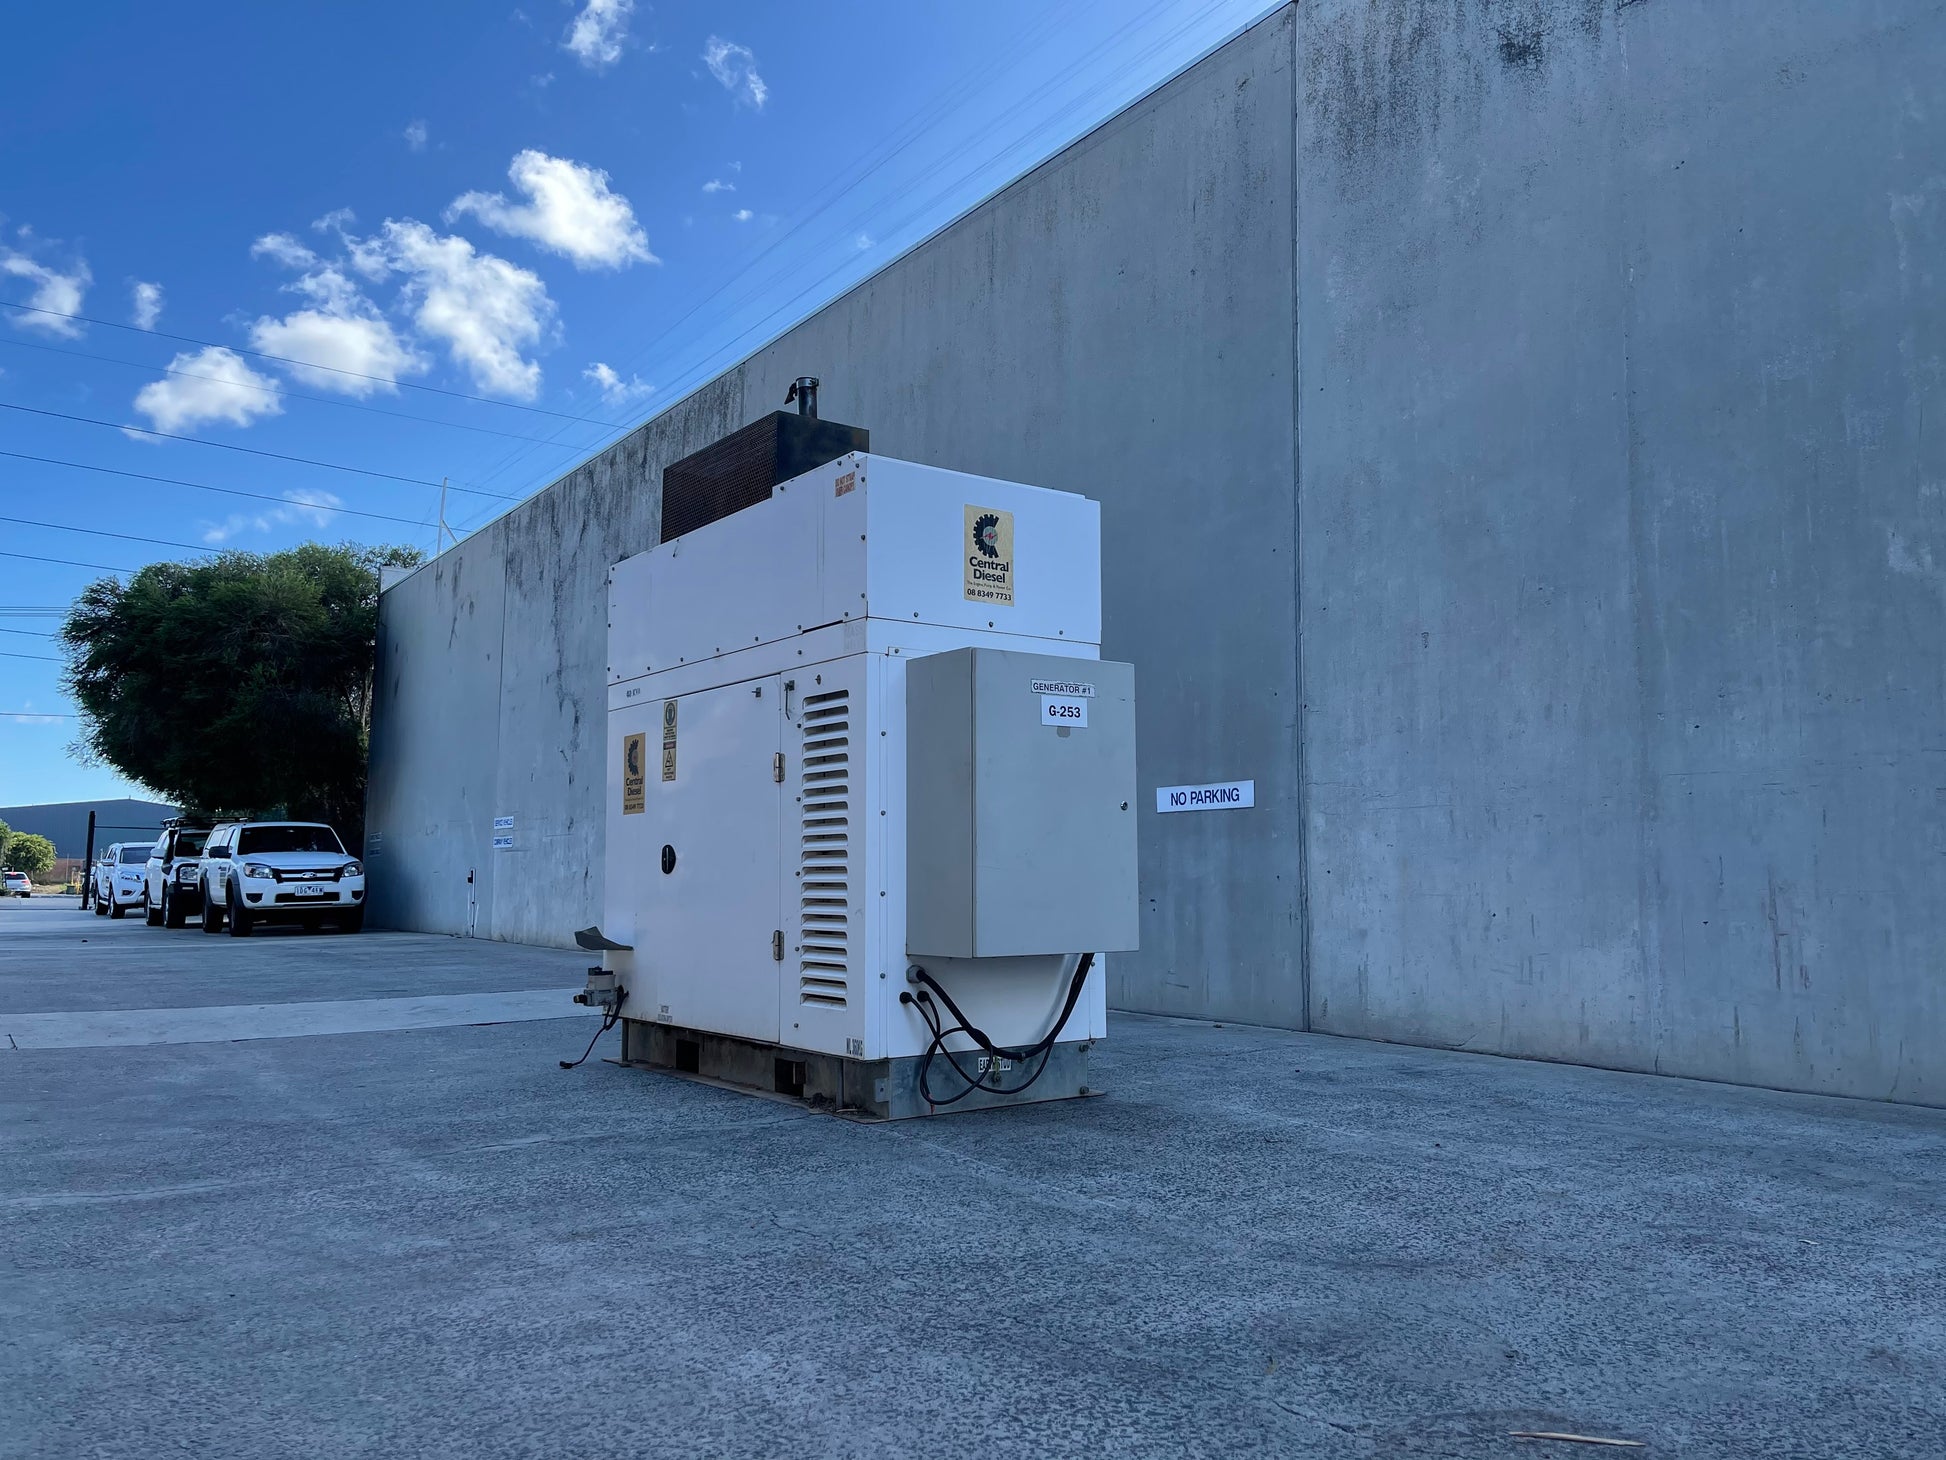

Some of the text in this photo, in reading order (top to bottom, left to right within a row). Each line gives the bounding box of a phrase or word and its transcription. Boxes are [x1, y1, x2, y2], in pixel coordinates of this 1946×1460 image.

[969, 556, 1009, 572] Central
[973, 568, 1006, 583] Diesel
[967, 588, 1012, 601] 08 8349 7733
[1033, 682, 1080, 694] GENERATOR
[1049, 705, 1081, 718] G-253
[1170, 787, 1240, 806] NO PARKING
